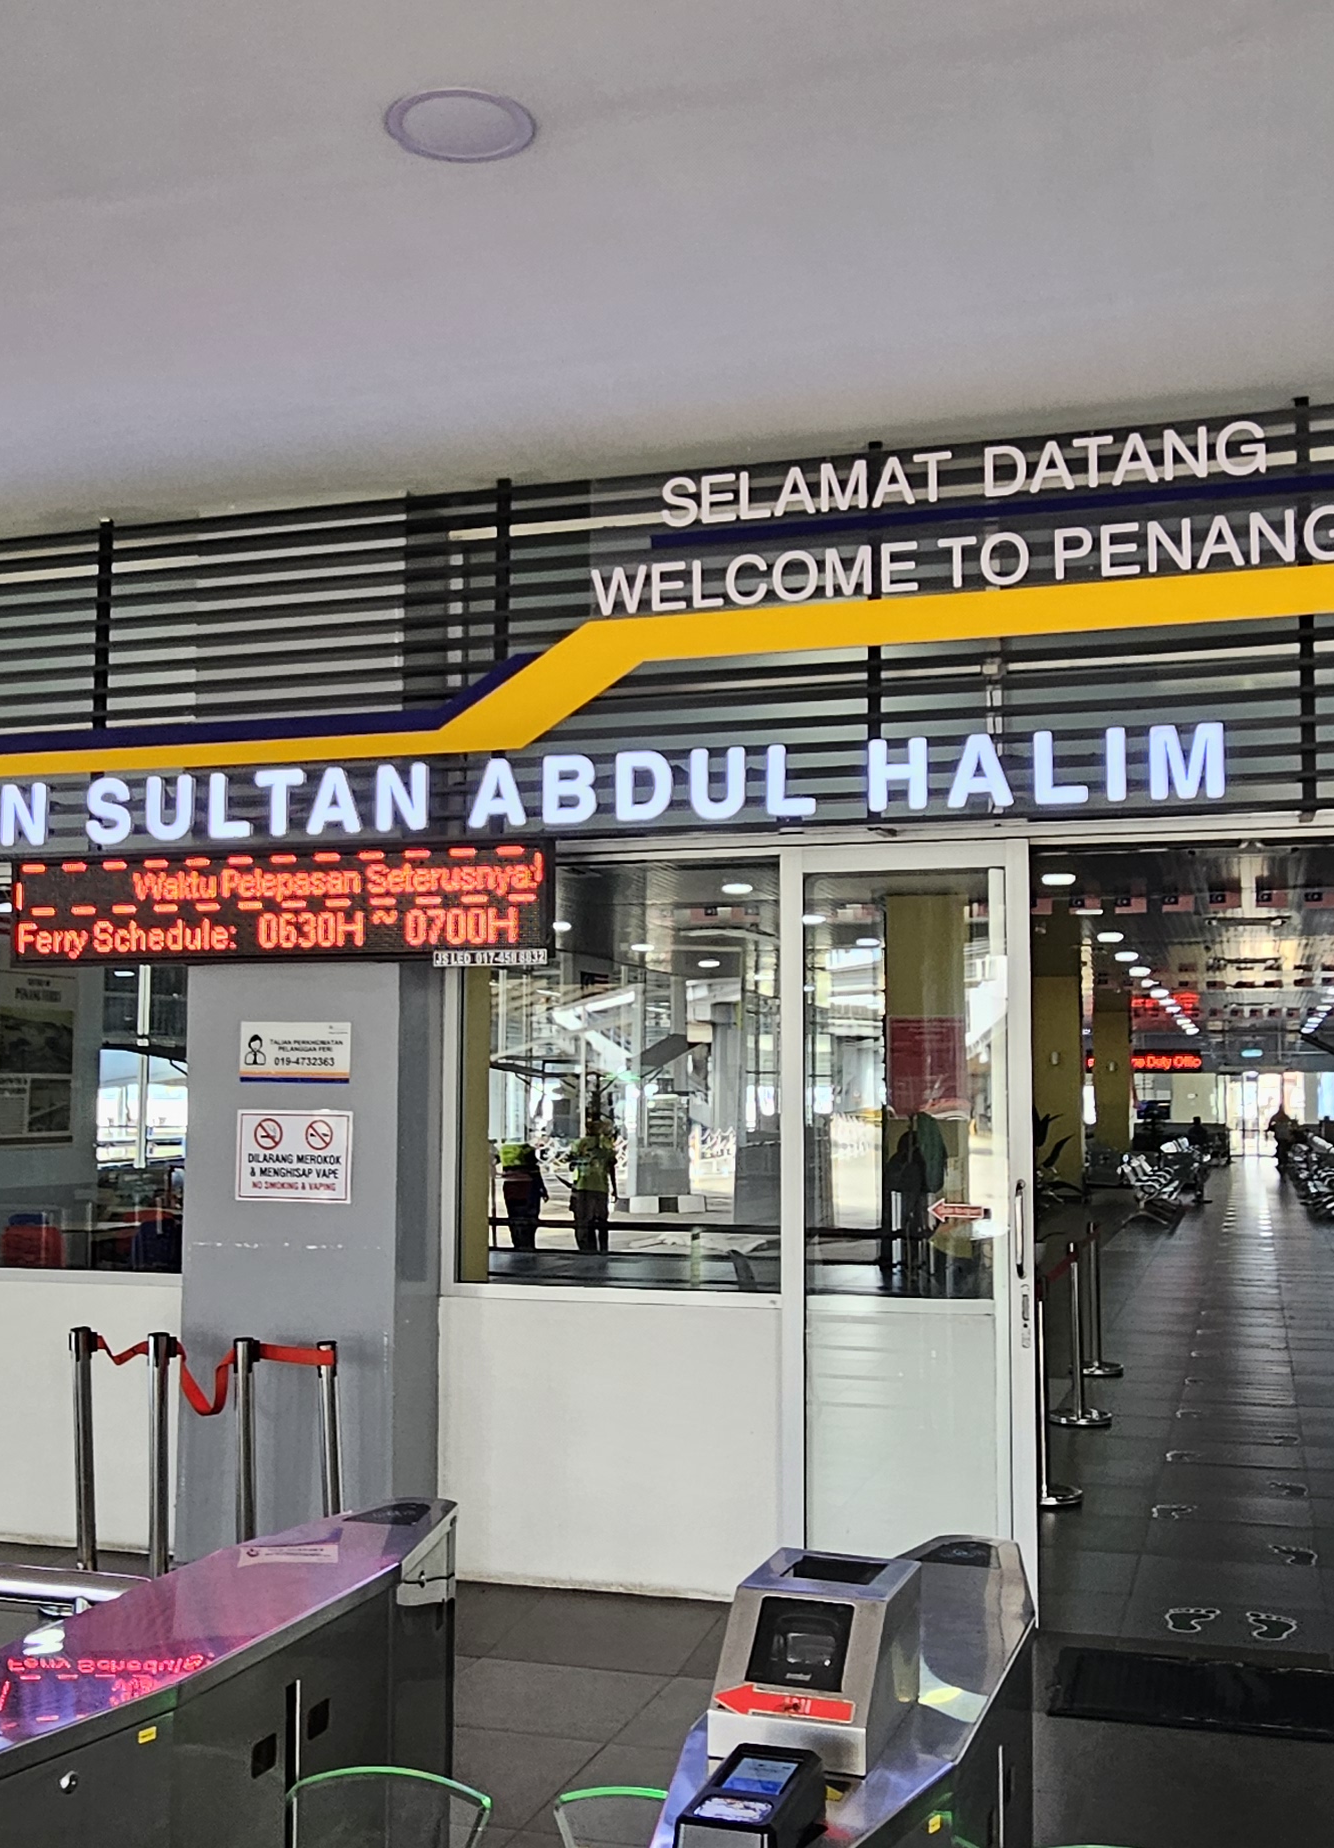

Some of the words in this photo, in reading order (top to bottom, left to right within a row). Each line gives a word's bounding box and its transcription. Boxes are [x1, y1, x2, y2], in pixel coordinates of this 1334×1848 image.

[660, 450, 953, 528] SELAMAT
[983, 420, 1268, 498] DATANG
[591, 541, 919, 617] WELCOME
[938, 531, 1030, 588] TO
[85, 761, 432, 846] SULTAN
[468, 744, 816, 830] ABDUL
[867, 721, 1226, 813] HALIM
[132, 872, 217, 901] Waktu
[219, 865, 362, 900] Pelepasan
[17, 922, 87, 960] Ferry
[93, 917, 237, 955] Schedule:
[257, 911, 364, 950] 0630H
[403, 906, 519, 948] 0700H
[248, 1153, 294, 1164] DILARANG
[296, 1154, 341, 1165] MEROKOK
[259, 1167, 313, 1178] MENGHISAP
[315, 1168, 339, 1179] VAPE
[252, 1181, 262, 1189] NO
[264, 1181, 299, 1190] SMOKING
